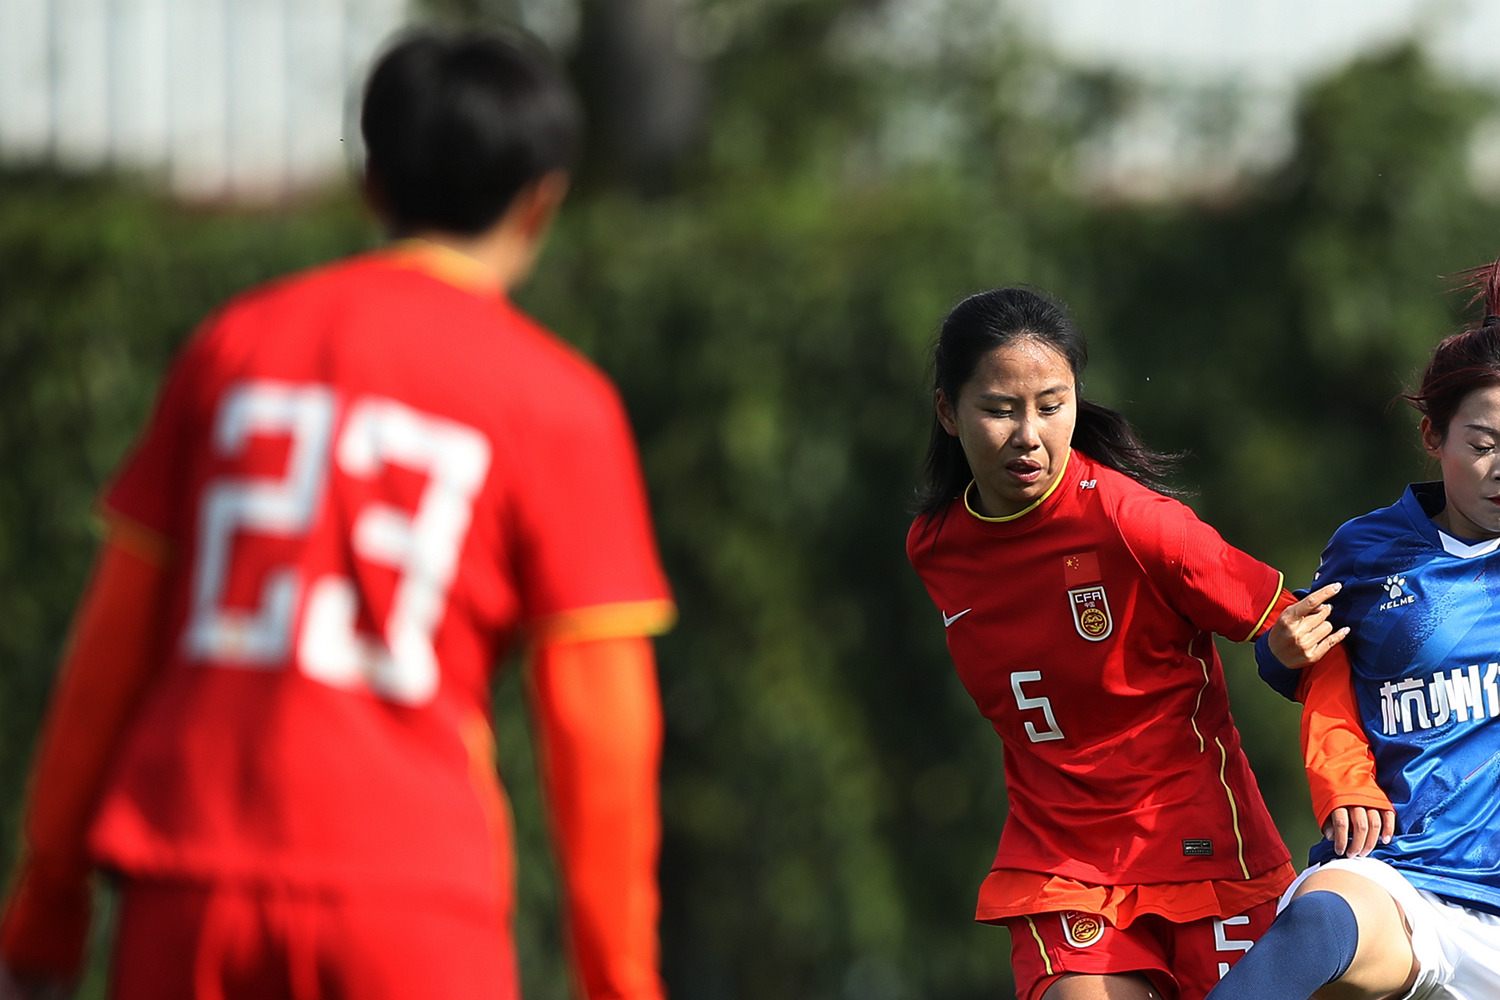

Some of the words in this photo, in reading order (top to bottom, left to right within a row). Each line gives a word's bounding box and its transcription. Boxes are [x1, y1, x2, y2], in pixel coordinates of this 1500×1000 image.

[183, 378, 492, 706] 23
[1075, 591, 1102, 604] CFA
[1379, 595, 1415, 611] KELME
[1010, 670, 1065, 743] 5
